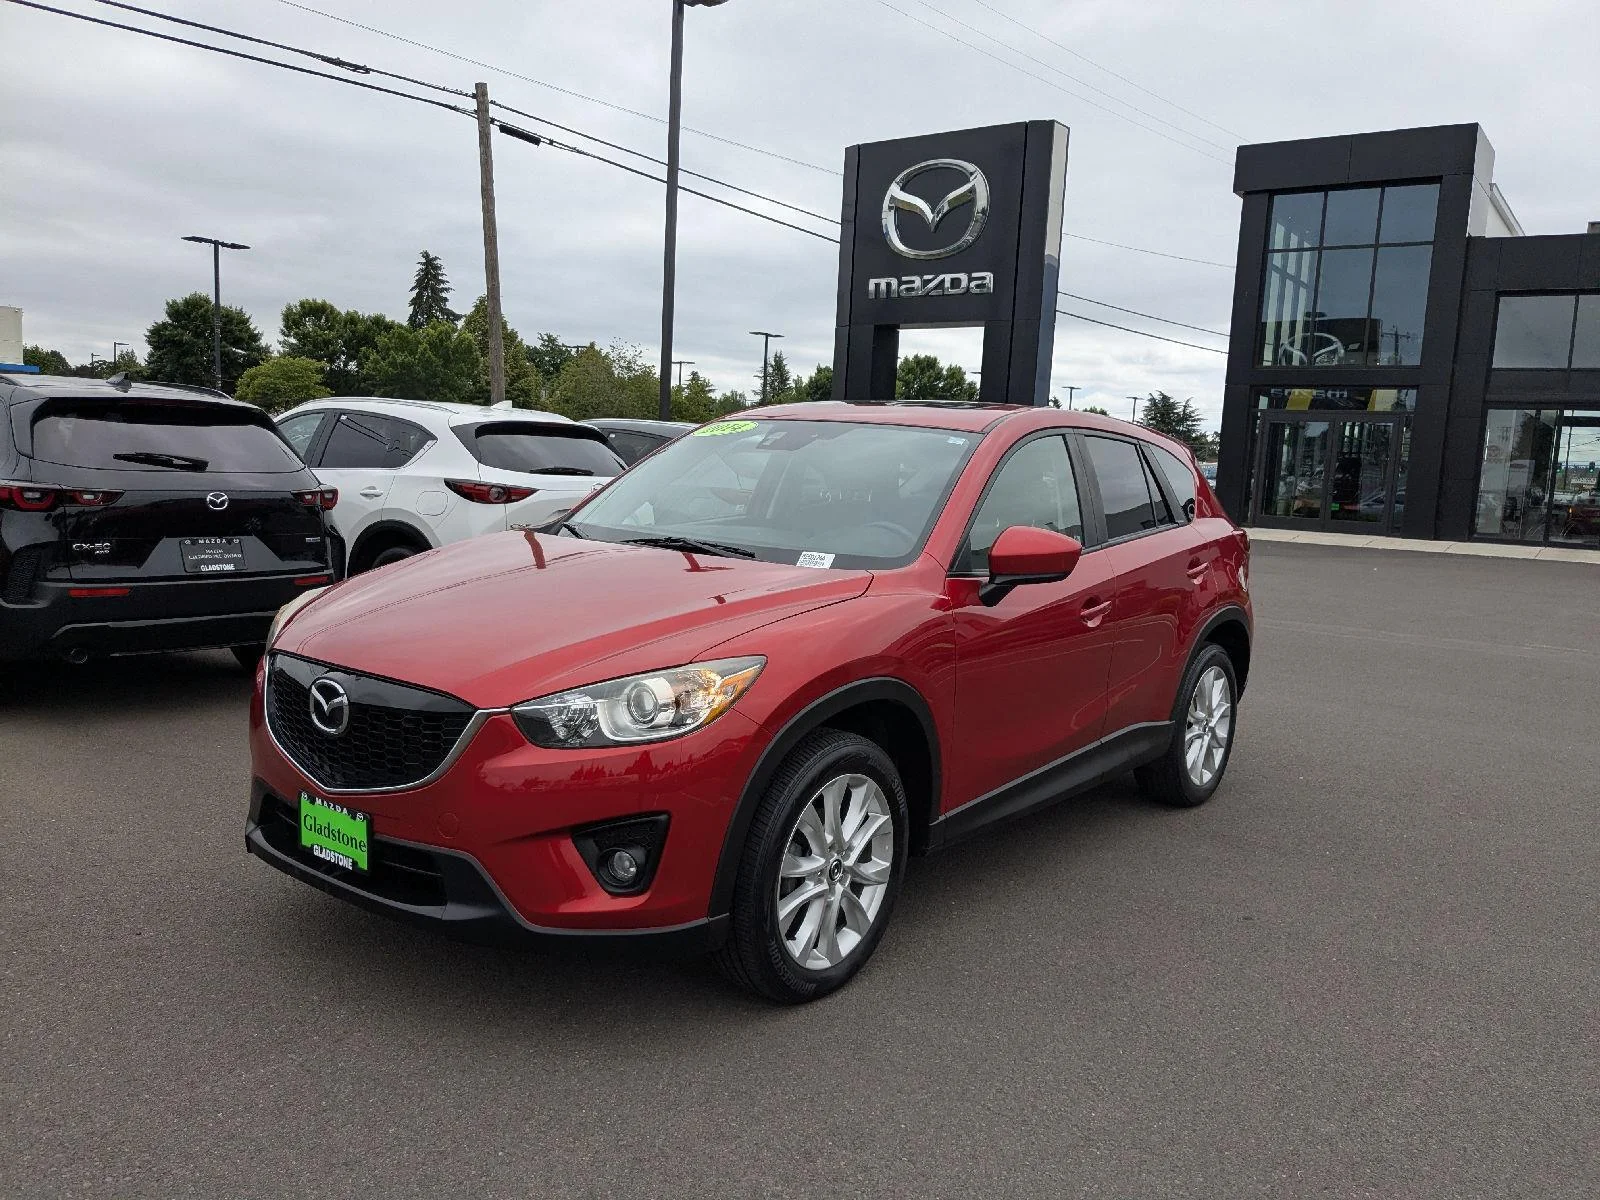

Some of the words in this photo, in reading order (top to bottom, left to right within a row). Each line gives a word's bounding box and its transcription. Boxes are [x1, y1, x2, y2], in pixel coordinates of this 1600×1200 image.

[867, 272, 994, 299] mazda
[200, 563, 236, 572] GLADSTONE
[314, 797, 348, 816] MAZDA
[303, 813, 367, 853] Gladstone
[313, 844, 353, 871] GLADSTONE
